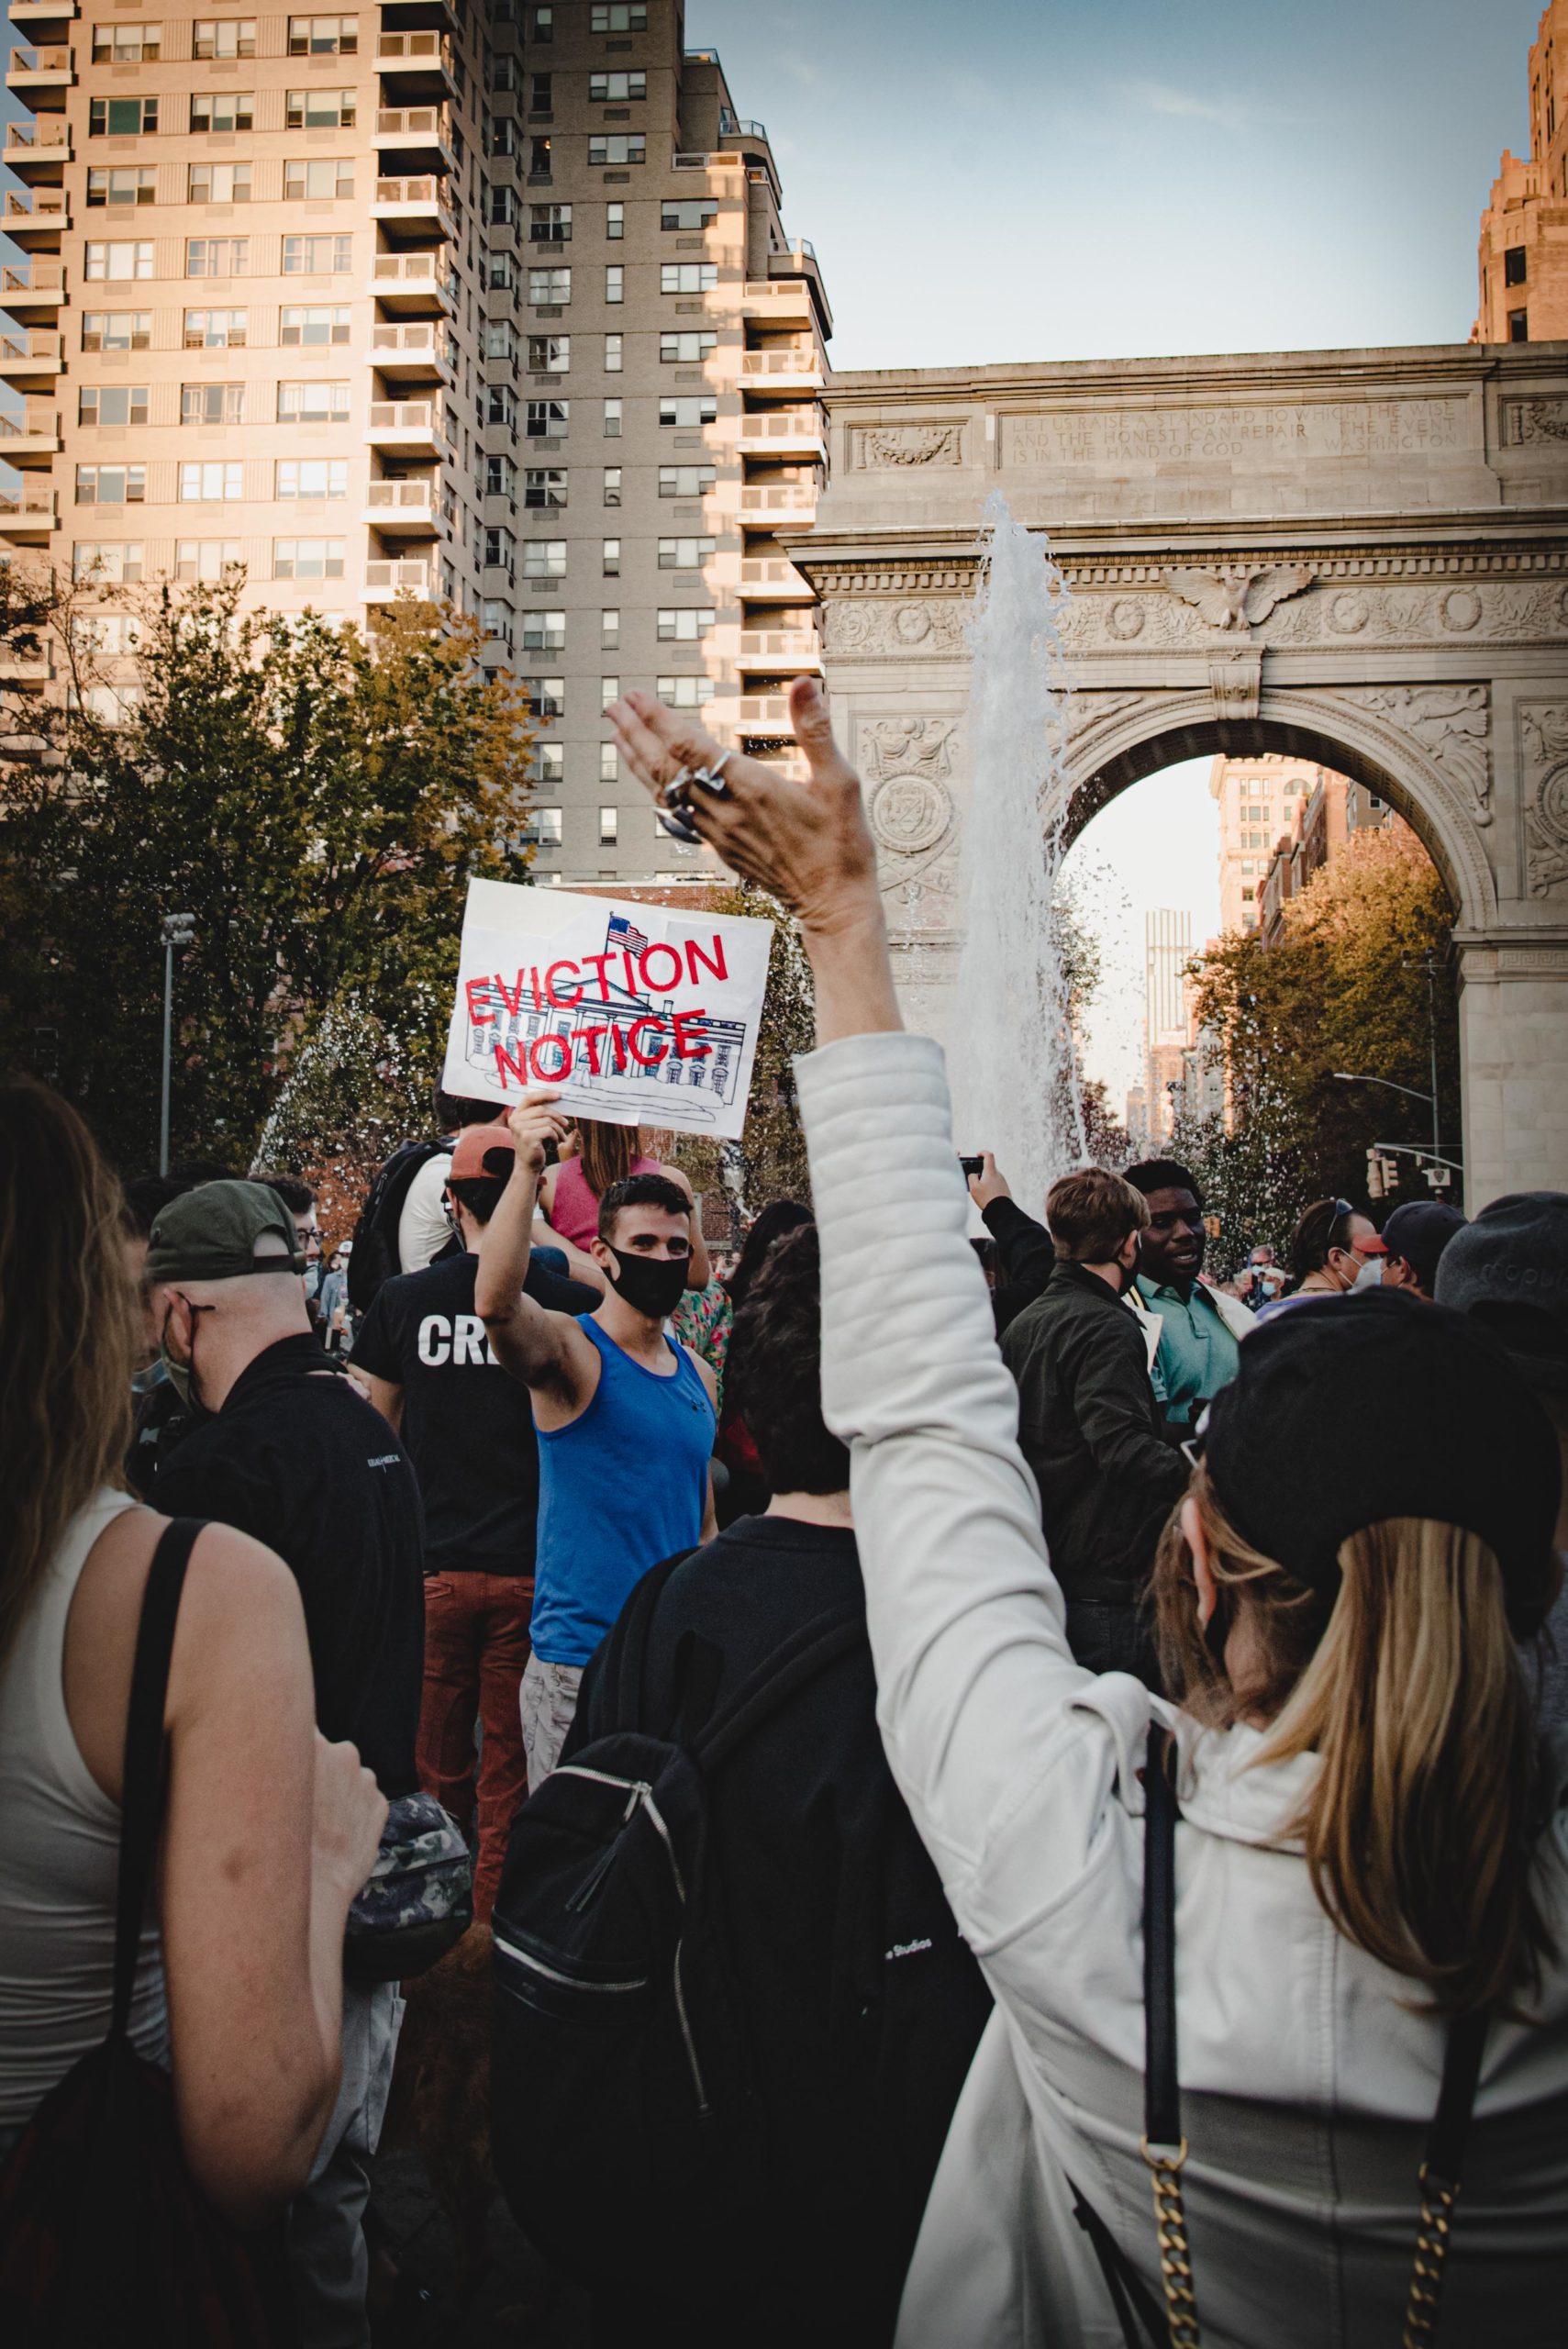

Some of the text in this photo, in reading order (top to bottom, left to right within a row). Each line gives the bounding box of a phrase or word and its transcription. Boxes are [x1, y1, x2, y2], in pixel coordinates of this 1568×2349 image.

[1013, 401, 1456, 432] LET US RAISE A STANDARD TO WHICH THE WISE
[1013, 417, 1456, 447] AND THE HONEST CAN REPAIR THE EVENT
[1013, 433, 1457, 462] IS IN THE HAND OF GOD WASHINGTON
[465, 935, 728, 1026] EVICTION
[494, 1009, 712, 1090] NOTICE
